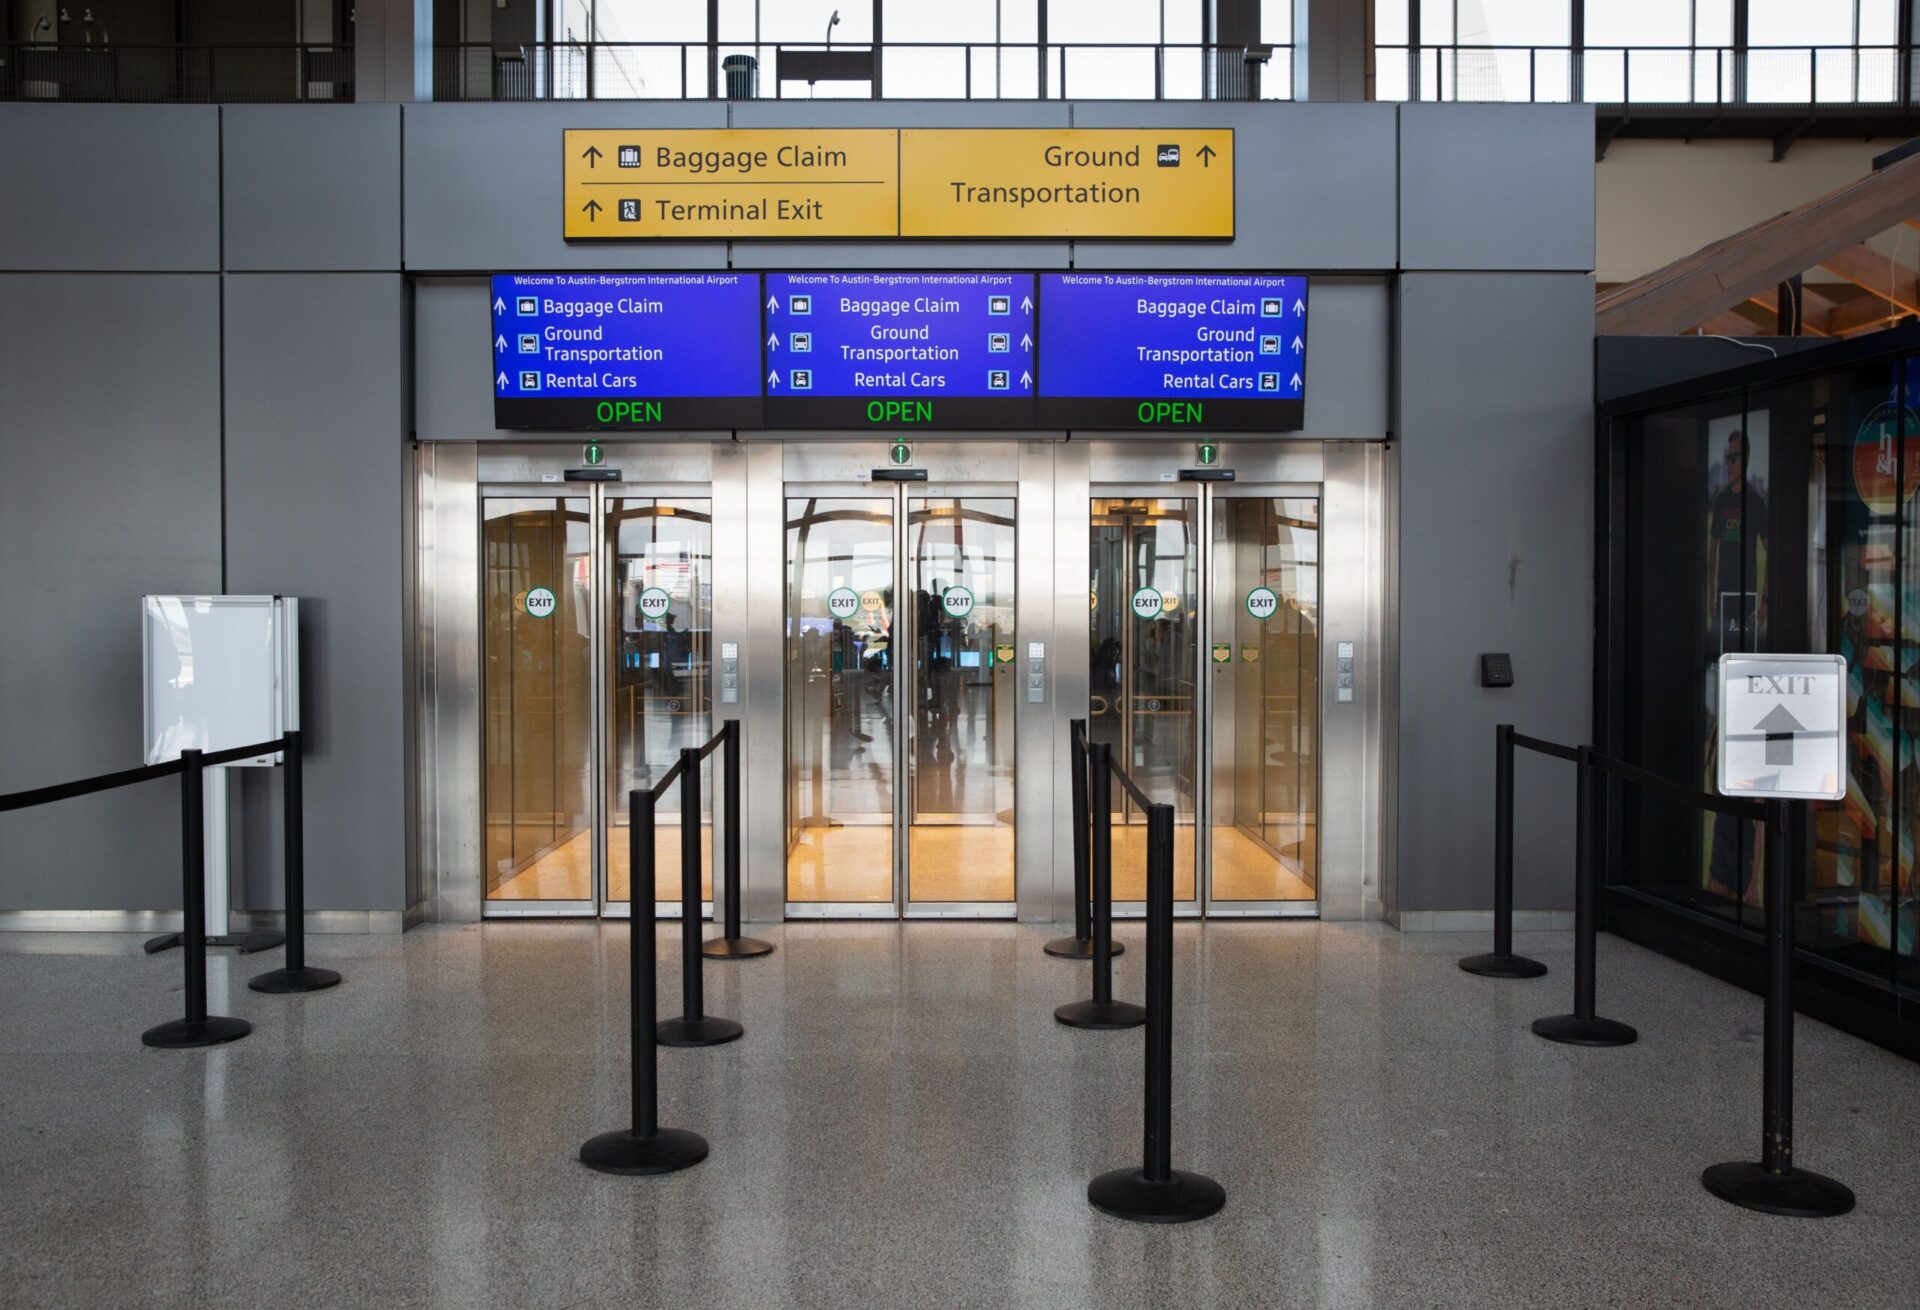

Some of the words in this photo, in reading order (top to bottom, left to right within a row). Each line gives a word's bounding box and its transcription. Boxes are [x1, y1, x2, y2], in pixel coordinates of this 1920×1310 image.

[657, 146, 768, 174] Baggage
[776, 145, 847, 167] Claim
[1044, 144, 1140, 167] Ground
[950, 181, 1140, 209] Transportation
[655, 198, 767, 221] Terminal
[777, 198, 823, 221] Exit
[514, 276, 555, 285] Welcome
[555, 276, 566, 285] To
[567, 275, 646, 287] Austin-Bergstrom
[647, 275, 705, 285] International
[706, 275, 738, 286] Airport
[787, 274, 828, 284] Welcome
[829, 274, 840, 284] To
[841, 274, 920, 286] Austin-Bergstrom
[921, 275, 979, 285] International
[980, 275, 1012, 286] Airport
[1062, 275, 1103, 285] Welcome
[1103, 275, 1114, 285] To
[1115, 275, 1194, 288] Austin-Bergstrom
[1195, 277, 1252, 287] International
[1253, 277, 1285, 288] Airport
[544, 299, 614, 318] Baggage
[617, 297, 663, 314] Claim
[840, 297, 910, 317] Baggage
[914, 297, 960, 313] Claim
[1137, 298, 1207, 318] Baggage
[1210, 298, 1256, 315] Claim
[544, 325, 603, 341] Ground
[870, 324, 929, 340] Ground
[1197, 326, 1255, 342] Ground
[544, 345, 663, 365] Transportation
[840, 345, 959, 364] Transportation
[1136, 346, 1254, 365] Transportation
[546, 372, 598, 388] Rental
[602, 372, 637, 388] Cars
[854, 371, 907, 387] Rental
[910, 371, 946, 387] Cars
[1163, 373, 1215, 389] Rental
[1218, 373, 1254, 389] Cars
[596, 401, 662, 423] OPEN
[866, 400, 933, 423] OPEN
[1137, 401, 1203, 423] OPEN
[528, 597, 553, 607] EXIT
[642, 598, 666, 608] EXIT
[831, 598, 855, 608] EXIT
[862, 598, 880, 606] EXIT
[946, 597, 970, 607] EXIT
[1135, 598, 1159, 608] EXIT
[1162, 597, 1177, 605] XIT
[1250, 598, 1274, 608] EXIT
[1746, 674, 1817, 696] EXIT
